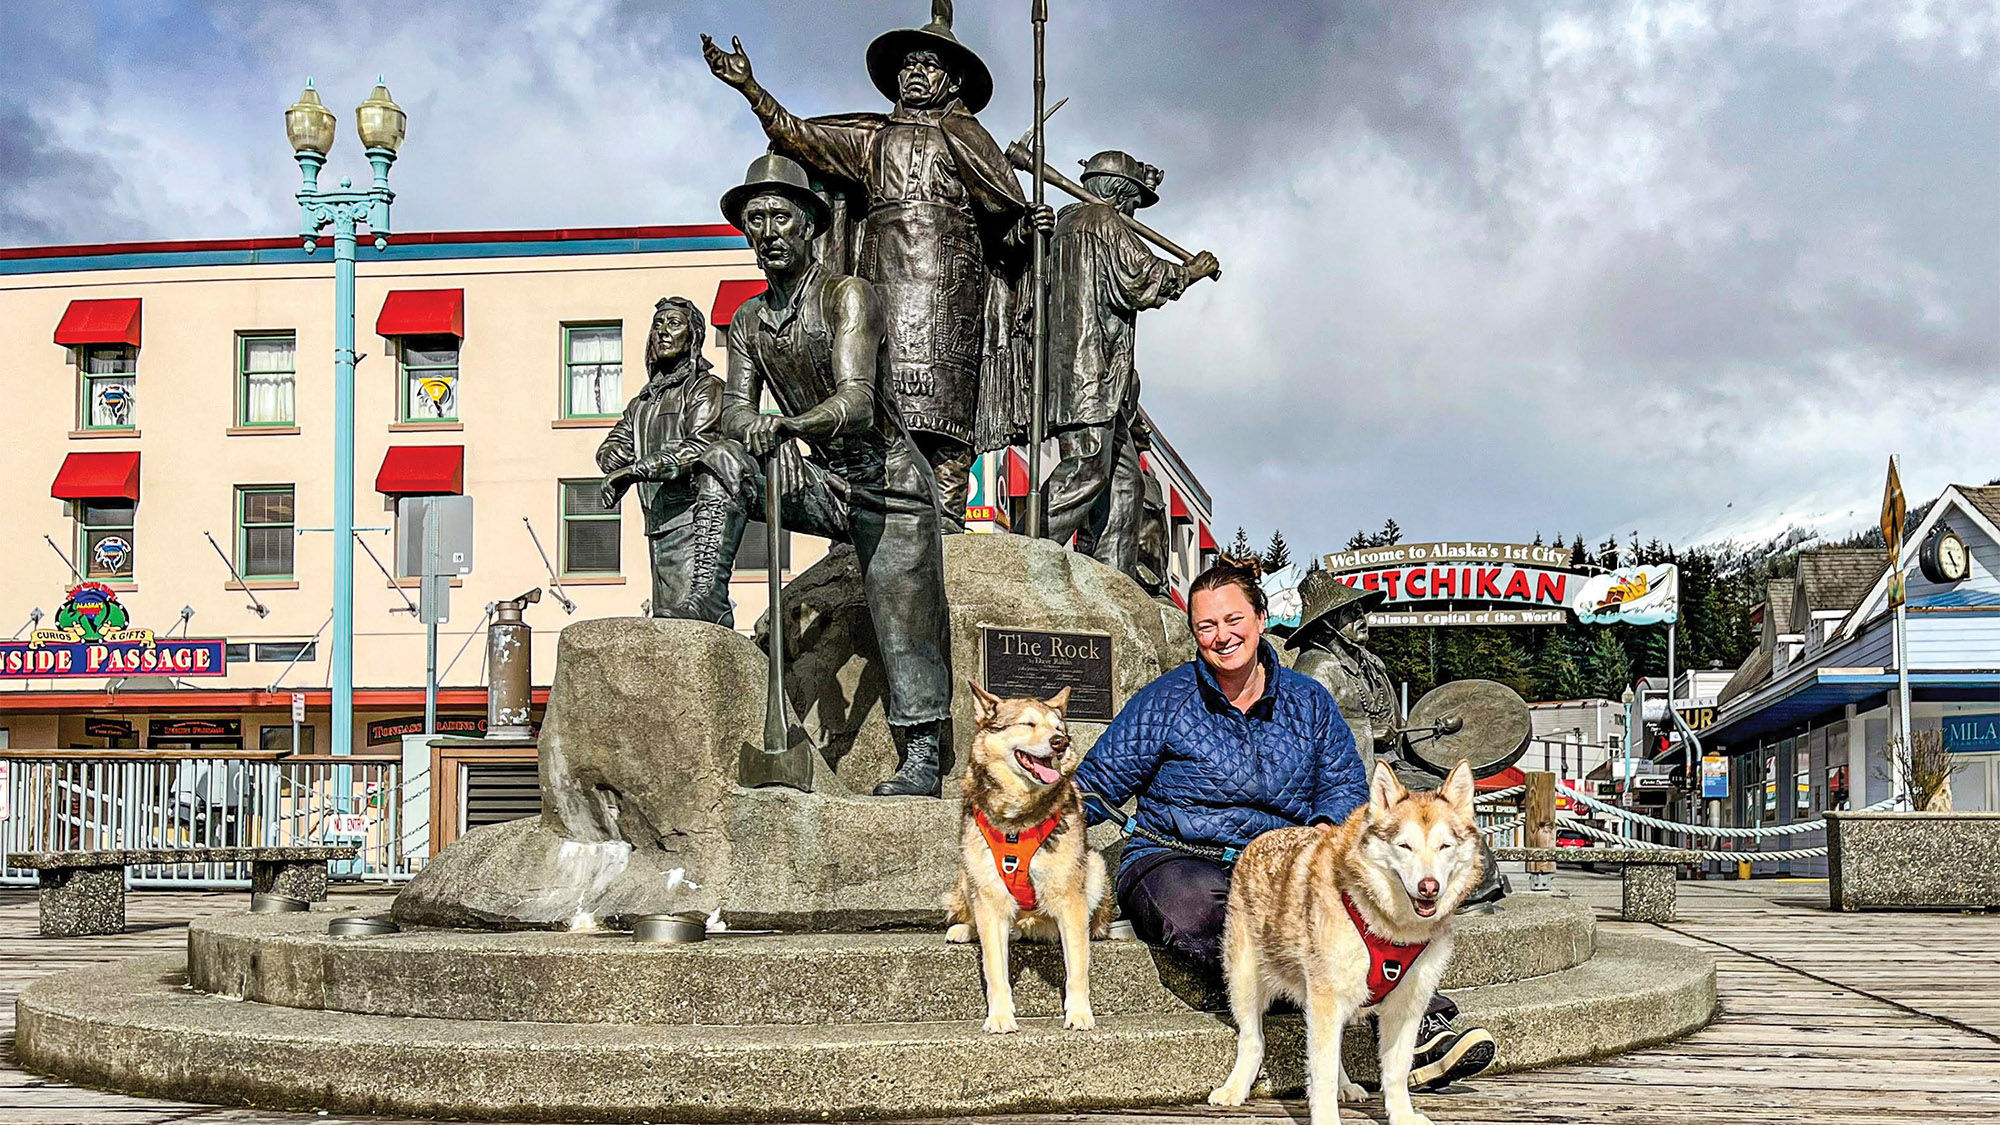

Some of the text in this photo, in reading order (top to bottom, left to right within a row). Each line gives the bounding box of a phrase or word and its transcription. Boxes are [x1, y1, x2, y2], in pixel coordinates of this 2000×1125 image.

[1330, 542, 1566, 569] Welcome to Alaska's 1st City
[1368, 611, 1561, 626] Salmon Capital of the World
[36, 631, 72, 641] CURIOS
[118, 630, 147, 640] GIFTS
[998, 633, 1101, 660] The Rock
[85, 645, 211, 673] PASSAGE
[373, 722, 423, 739] TONGASS
[436, 720, 474, 732] RADING
